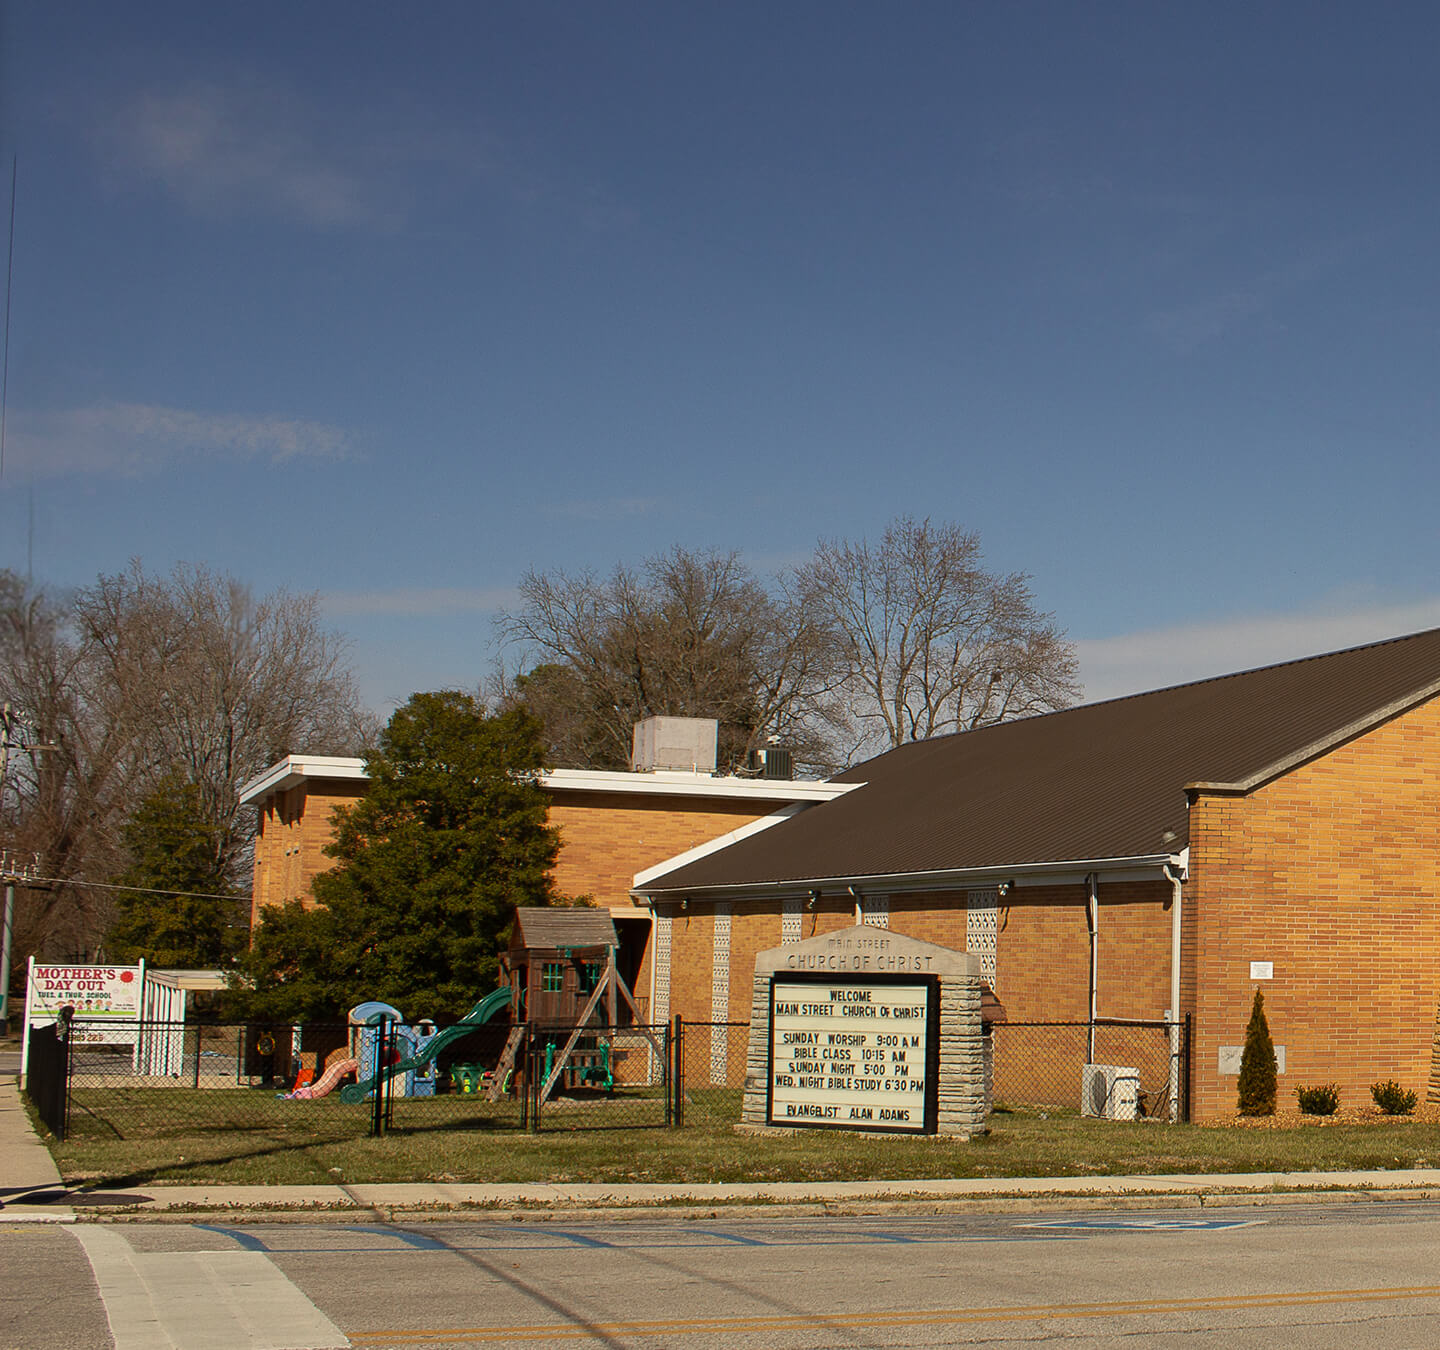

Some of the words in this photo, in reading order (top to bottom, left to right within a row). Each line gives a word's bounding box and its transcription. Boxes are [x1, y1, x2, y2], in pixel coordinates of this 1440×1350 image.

[828, 938, 852, 948] MAIN
[857, 938, 890, 949] STREET
[787, 954, 847, 969] CHURCH
[852, 955, 871, 969] OF
[876, 956, 933, 970] CHRIST
[36, 968, 116, 980] MOTHER'S
[44, 980, 74, 990] DAY
[77, 981, 106, 991] OUT
[830, 990, 872, 1002] WELCOME
[776, 1003, 799, 1015] MAIN
[802, 1004, 834, 1016] STREET
[842, 1005, 876, 1017] CHURCH
[880, 1006, 890, 1017] OF
[893, 1007, 925, 1018] CHRIST
[783, 1032, 819, 1045] SUNDAY
[827, 1034, 866, 1047] WORSHIP
[876, 1035, 898, 1047] 9:00
[794, 1048, 818, 1059] BIBLE
[822, 1049, 851, 1060] CLASS
[861, 1049, 885, 1061] 10:15
[892, 1050, 906, 1062] AM
[788, 1062, 825, 1074] SUNDAY
[831, 1064, 855, 1075] NIGHT
[864, 1064, 885, 1076] 5:00
[894, 1065, 909, 1076] PM
[776, 1075, 797, 1088] WED.
[799, 1076, 825, 1088] NIGHT
[828, 1078, 852, 1090] BIBLE
[854, 1079, 881, 1091] STUDY
[909, 1081, 924, 1093] PM
[849, 1108, 873, 1120] ALAN
[879, 1109, 910, 1121] ADAMS
